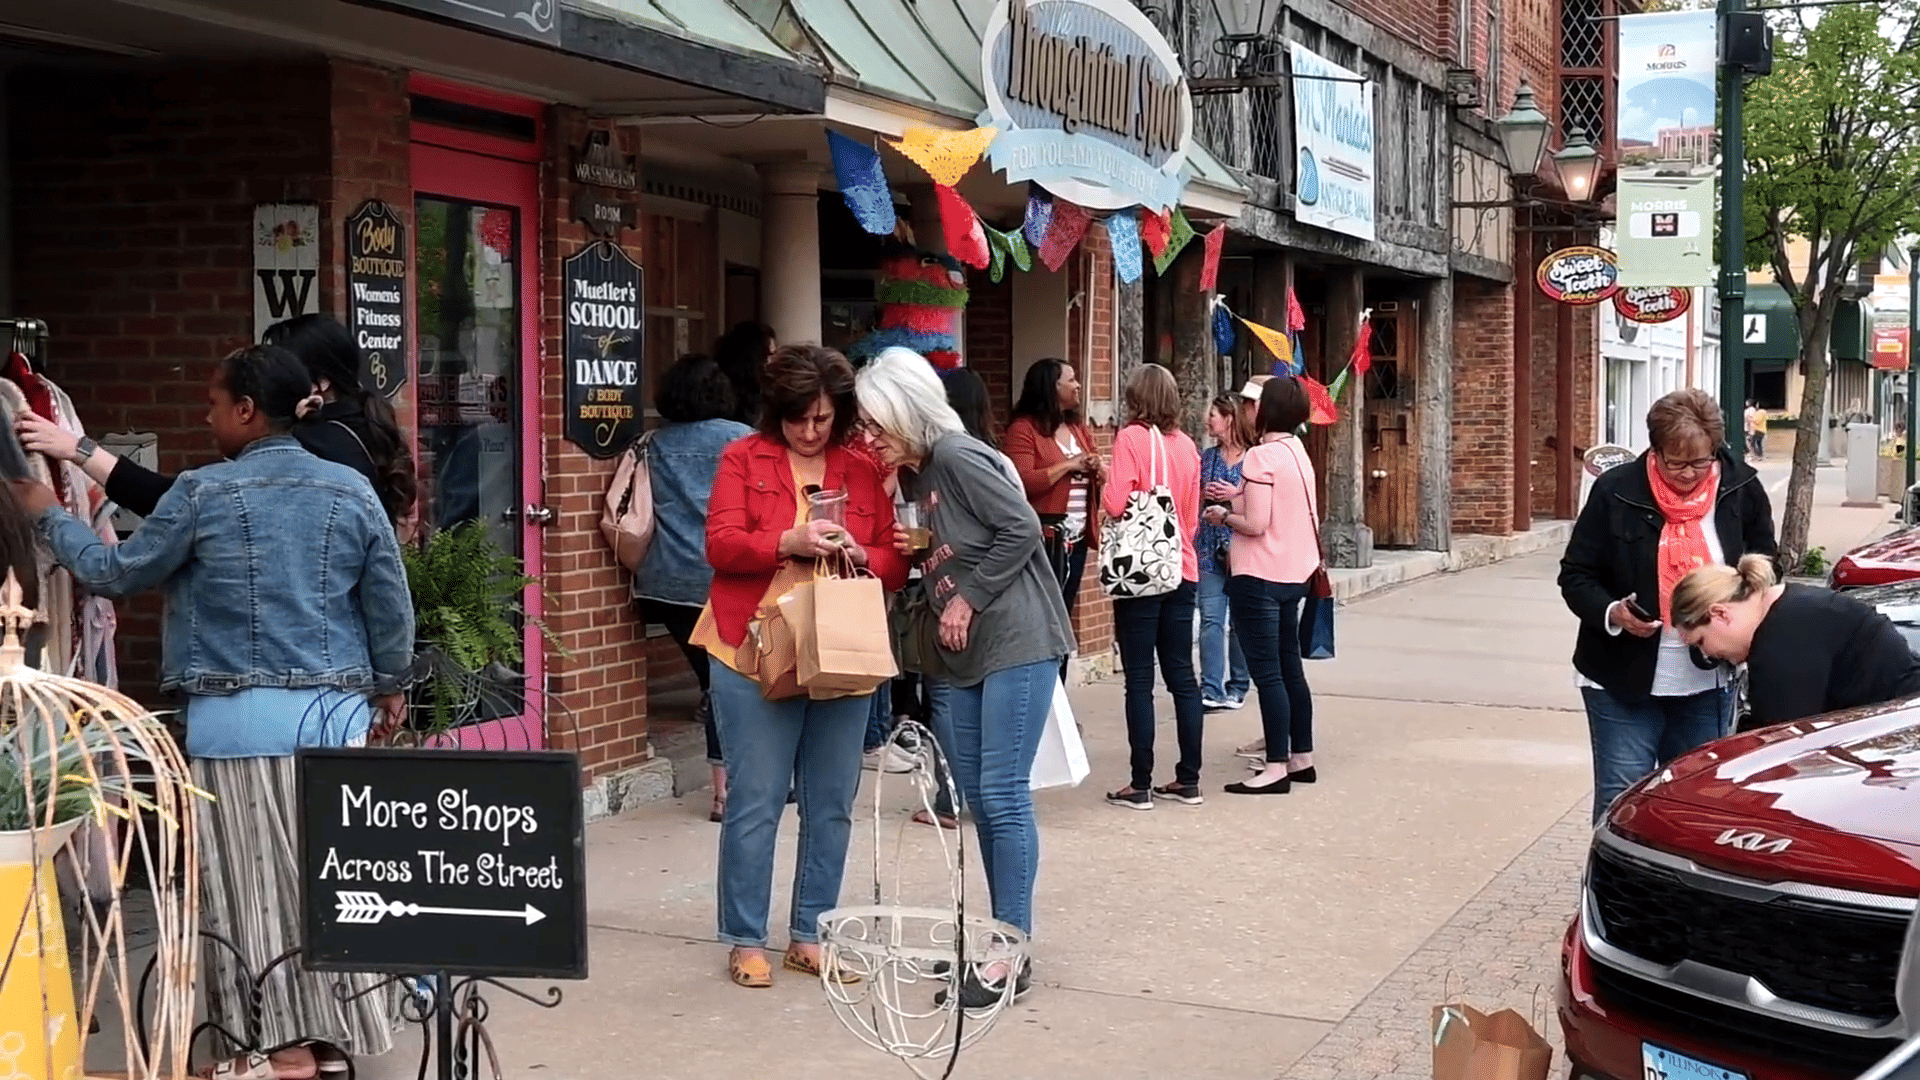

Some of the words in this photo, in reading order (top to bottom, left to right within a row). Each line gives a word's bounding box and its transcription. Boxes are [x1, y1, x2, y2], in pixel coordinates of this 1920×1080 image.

[1646, 60, 1687, 71] MORRIS
[1006, 0, 1133, 135] Thoughtful
[1134, 54, 1184, 157] Spot
[1012, 145, 1038, 170] FOR
[1041, 142, 1064, 167] YOU
[1067, 143, 1093, 168] AND
[1096, 150, 1125, 182] YOUR
[575, 163, 637, 188] WASHINGTON
[594, 203, 621, 222] ROOM
[1631, 199, 1687, 211] MORRIS
[357, 217, 396, 254] Body
[352, 256, 404, 277] BOUTIQUE
[1549, 254, 1604, 283] Sweet
[354, 283, 401, 303] Women's
[573, 278, 636, 303] Mueller's
[1564, 272, 1611, 293] Tooth
[356, 307, 401, 327] Fitness
[569, 301, 641, 330] SCHOOL
[1639, 296, 1678, 313] Tooth
[358, 330, 402, 349] Center
[575, 359, 638, 386] DANCE
[596, 389, 625, 402] BODY
[341, 784, 428, 829] More
[437, 788, 538, 846] Shops
[319, 847, 413, 883] Across
[417, 850, 470, 885] The
[476, 853, 563, 889] Street
[1667, 1053, 1722, 1080] ILLINOIS
